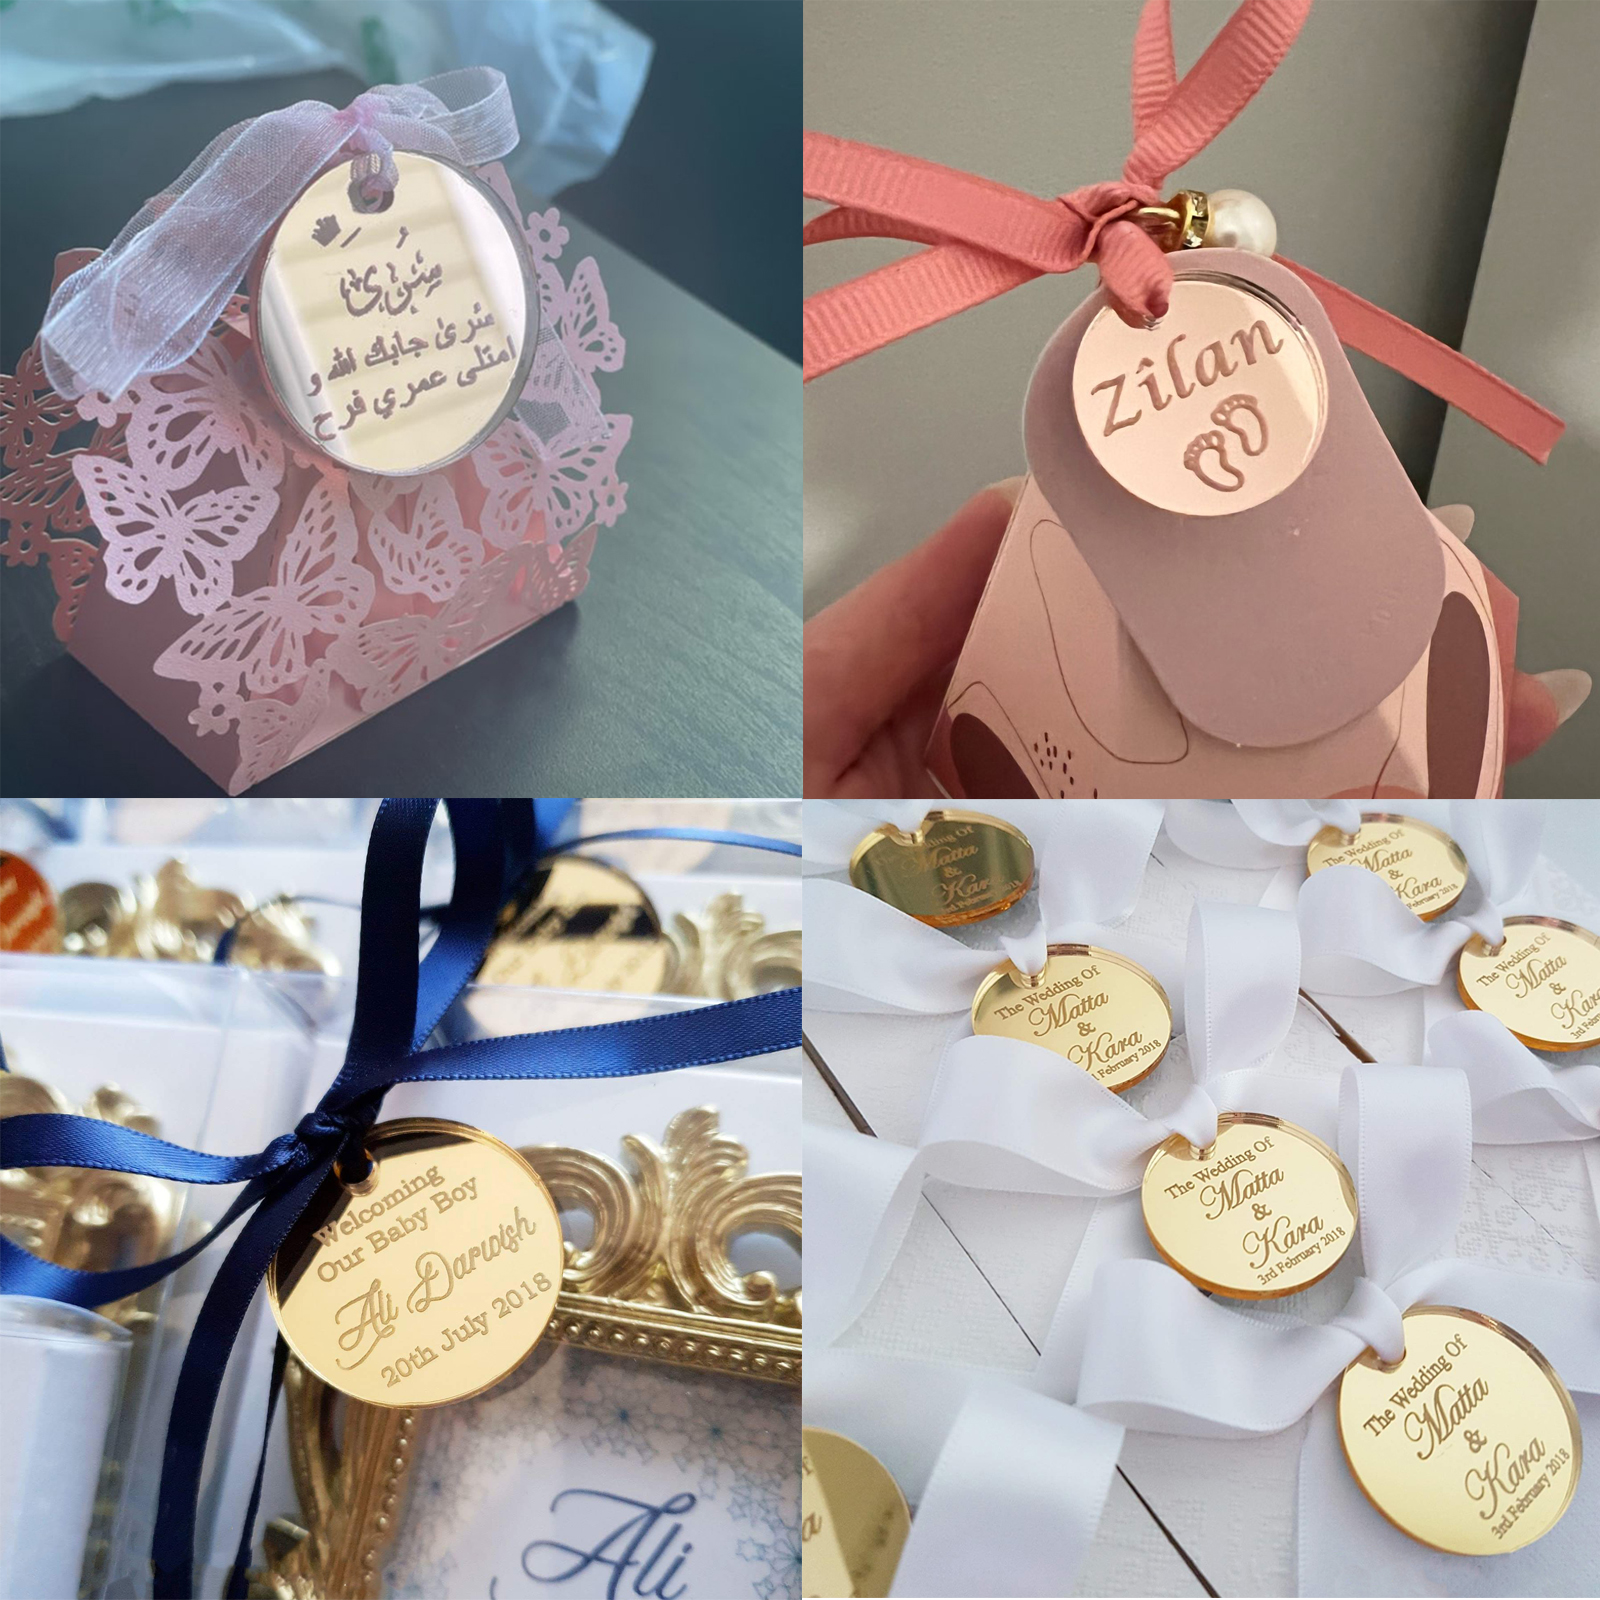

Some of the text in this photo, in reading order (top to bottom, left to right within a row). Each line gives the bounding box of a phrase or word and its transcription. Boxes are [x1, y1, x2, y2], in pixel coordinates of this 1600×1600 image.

[306, 373, 322, 397] و
[327, 347, 357, 381] الله
[312, 389, 367, 442] فرح
[943, 866, 963, 879] &
[1322, 829, 1406, 867] The Wedding Of
[1349, 848, 1413, 873] Matta
[1388, 869, 1404, 880] &
[1390, 876, 1443, 900] Kara
[1476, 932, 1551, 987] The Wedding Of
[1505, 956, 1567, 999] Matta
[994, 965, 1102, 1021] The Wedding Of
[1548, 981, 1566, 995] &
[1028, 991, 1109, 1037] Matta
[1077, 1021, 1096, 1037] &
[1570, 1027, 1586, 1040] 3rd
[1067, 1029, 1143, 1072] Kara
[1099, 1052, 1141, 1081] February
[1138, 1039, 1162, 1056] 2018
[1164, 1136, 1275, 1200] The Wedding Of
[312, 1165, 446, 1248] Welcoming
[1200, 1168, 1284, 1220] Matta
[1251, 1203, 1272, 1221] &
[317, 1177, 479, 1283] Our Baby Boy
[1242, 1215, 1324, 1270] Kara
[1257, 1226, 1346, 1286] 3rd February 2018
[334, 1206, 537, 1371] Ali Darwish
[380, 1271, 553, 1389] 20th July 2018
[1363, 1333, 1468, 1437] The Wedding Of
[1404, 1377, 1489, 1461] Matta
[1463, 1429, 1487, 1454] &
[1465, 1437, 1546, 1520] Kara
[1491, 1447, 1571, 1540] 3rd February 2018
[490, 1488, 697, 1599] Ali
